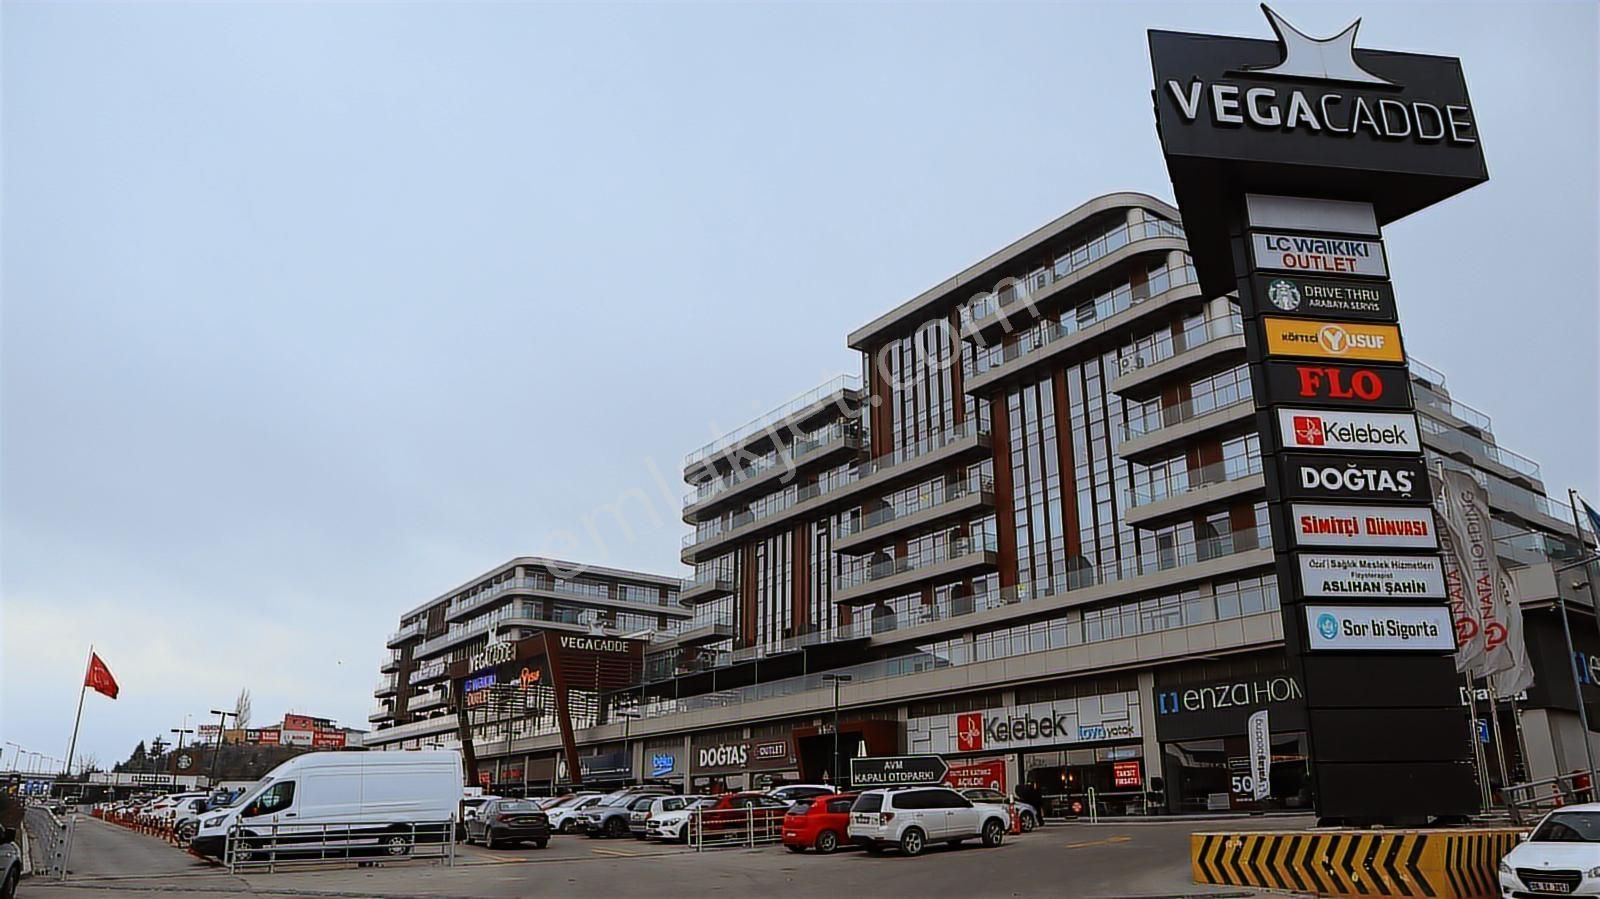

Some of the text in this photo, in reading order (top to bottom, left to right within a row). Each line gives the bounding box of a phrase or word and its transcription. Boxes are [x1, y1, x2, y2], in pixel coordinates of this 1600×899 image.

[1167, 79, 1477, 145] VEGACADDE
[1265, 236, 1292, 251] LC
[1282, 253, 1357, 273] OUTLET
[1304, 285, 1380, 301] DRIVE THRU
[1309, 299, 1349, 309] ARABAYA
[1323, 330, 1384, 351] YUSUF
[1296, 366, 1383, 401] FLO
[1323, 421, 1408, 445] Kelebek
[1300, 463, 1412, 498] DOĞTAŞ
[1359, 560, 1389, 569] Meslek
[1391, 560, 1435, 570] Hizmetleri
[1322, 579, 1426, 596] ASLIHAN ŞAHİN
[1475, 574, 1496, 621] NATA
[1342, 619, 1438, 640] Sor bi Sigorta
[560, 635, 629, 653] VEGACADDE
[1183, 682, 1250, 711] enza
[983, 710, 1069, 744] Kelebek
[699, 743, 748, 768] DOĞTAŞ
[759, 744, 784, 756] OUTLET
[884, 760, 904, 770] AVM
[854, 771, 934, 783] KAPALI OTOPARKI
[1231, 775, 1254, 793] 50
